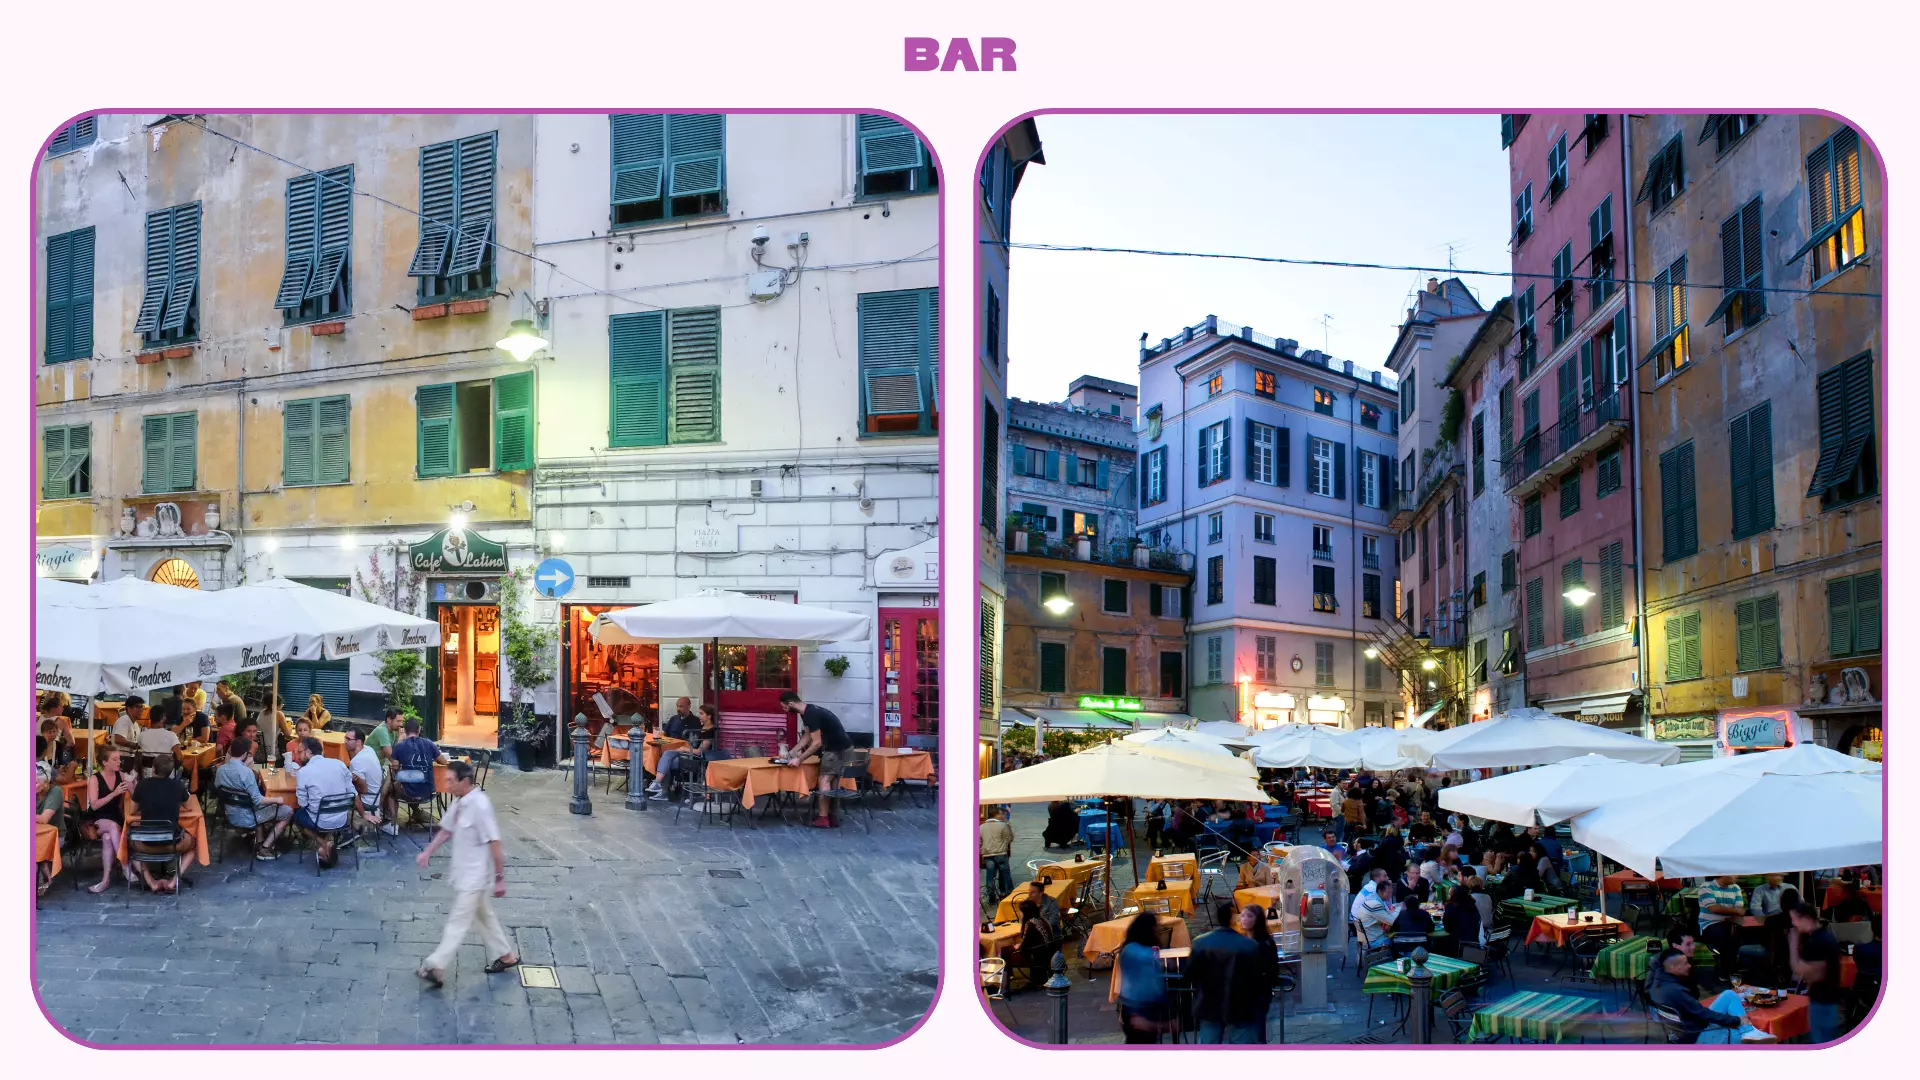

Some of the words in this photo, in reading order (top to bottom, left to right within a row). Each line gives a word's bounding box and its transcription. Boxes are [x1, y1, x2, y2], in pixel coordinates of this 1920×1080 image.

[463, 551, 505, 568] Latino
[241, 644, 280, 668] Menabrea
[36, 661, 72, 689] enabrea
[128, 662, 171, 689] Menabrea
[1727, 720, 1771, 742] Biggie
